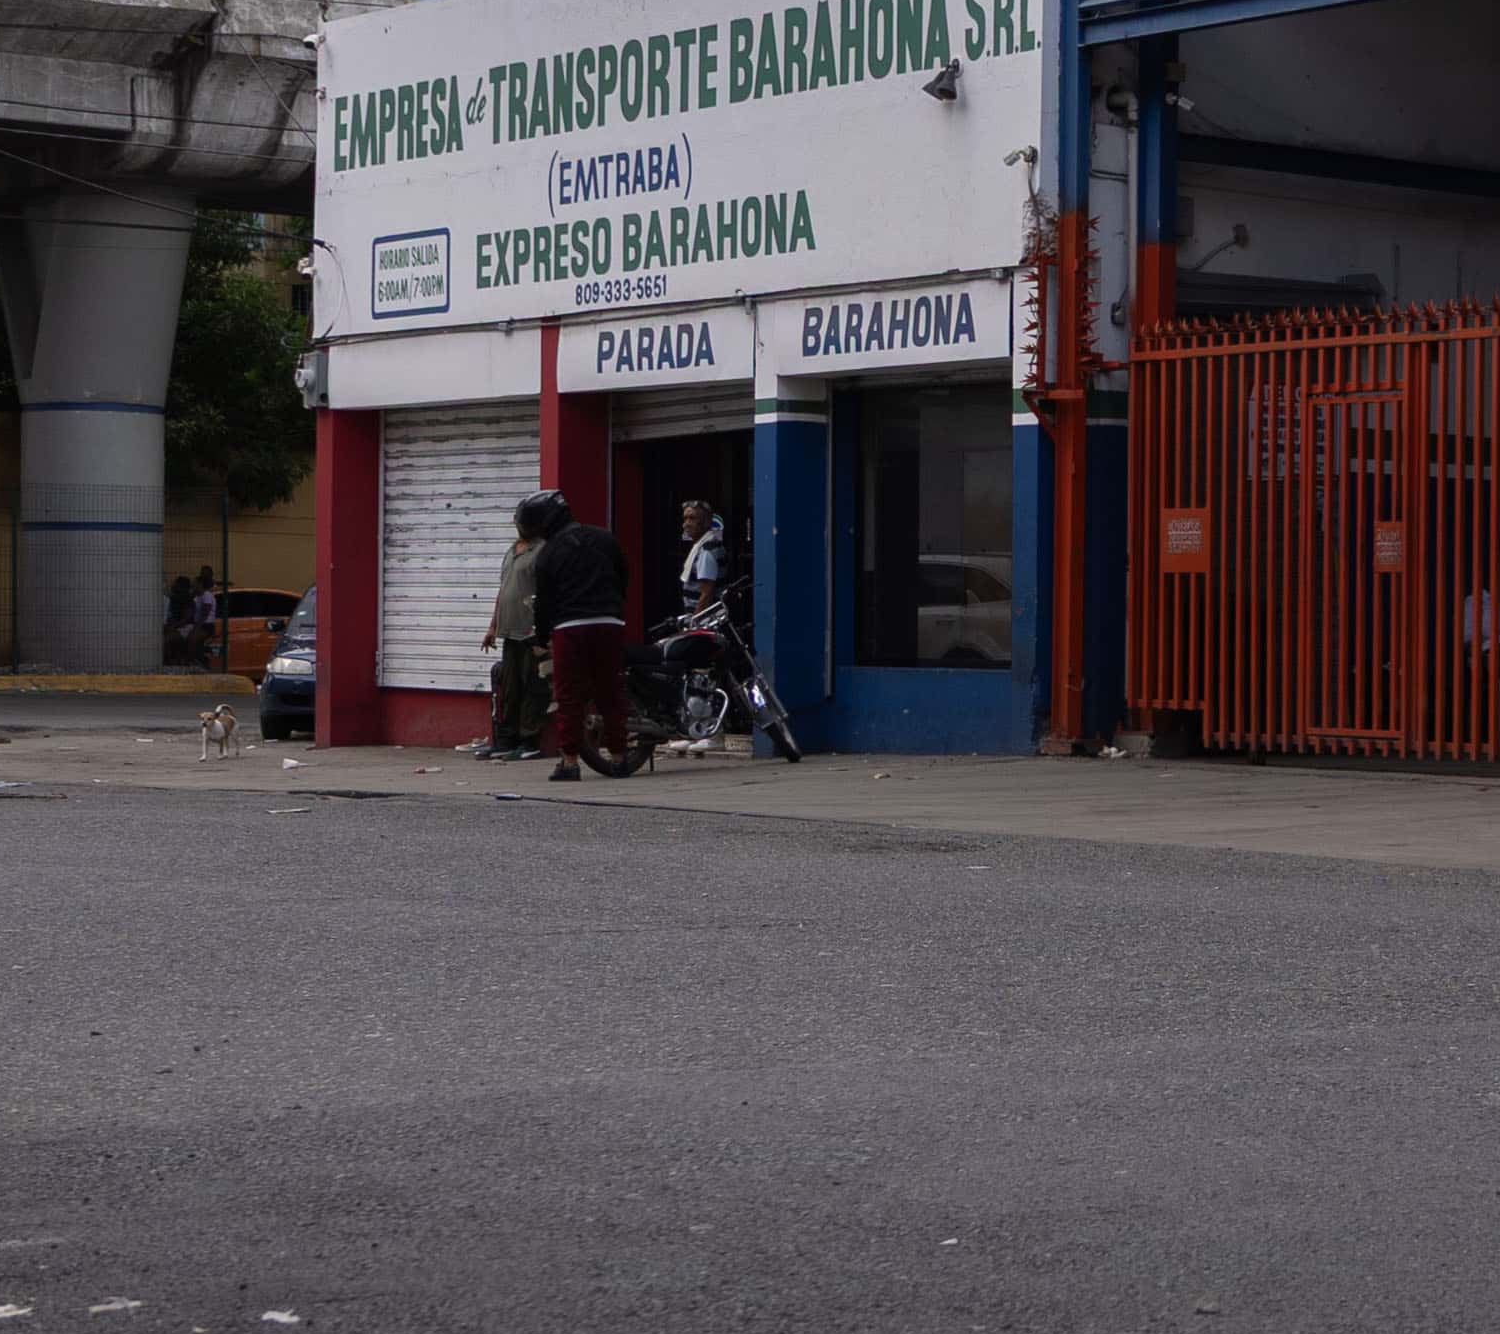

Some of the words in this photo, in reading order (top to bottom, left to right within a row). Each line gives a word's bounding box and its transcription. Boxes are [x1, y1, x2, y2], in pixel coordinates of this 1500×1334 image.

[334, 75, 464, 172] EMPRESA
[466, 77, 487, 125] de
[489, 24, 718, 144] TRANSPORTE
[548, 132, 693, 218] (EMTRABA)
[476, 217, 612, 289] EXPRESO
[623, 190, 816, 272] BARAHONA
[575, 274, 667, 306] 809-333-5651
[802, 292, 976, 357] BARAHONA
[597, 322, 715, 374] PARADA
